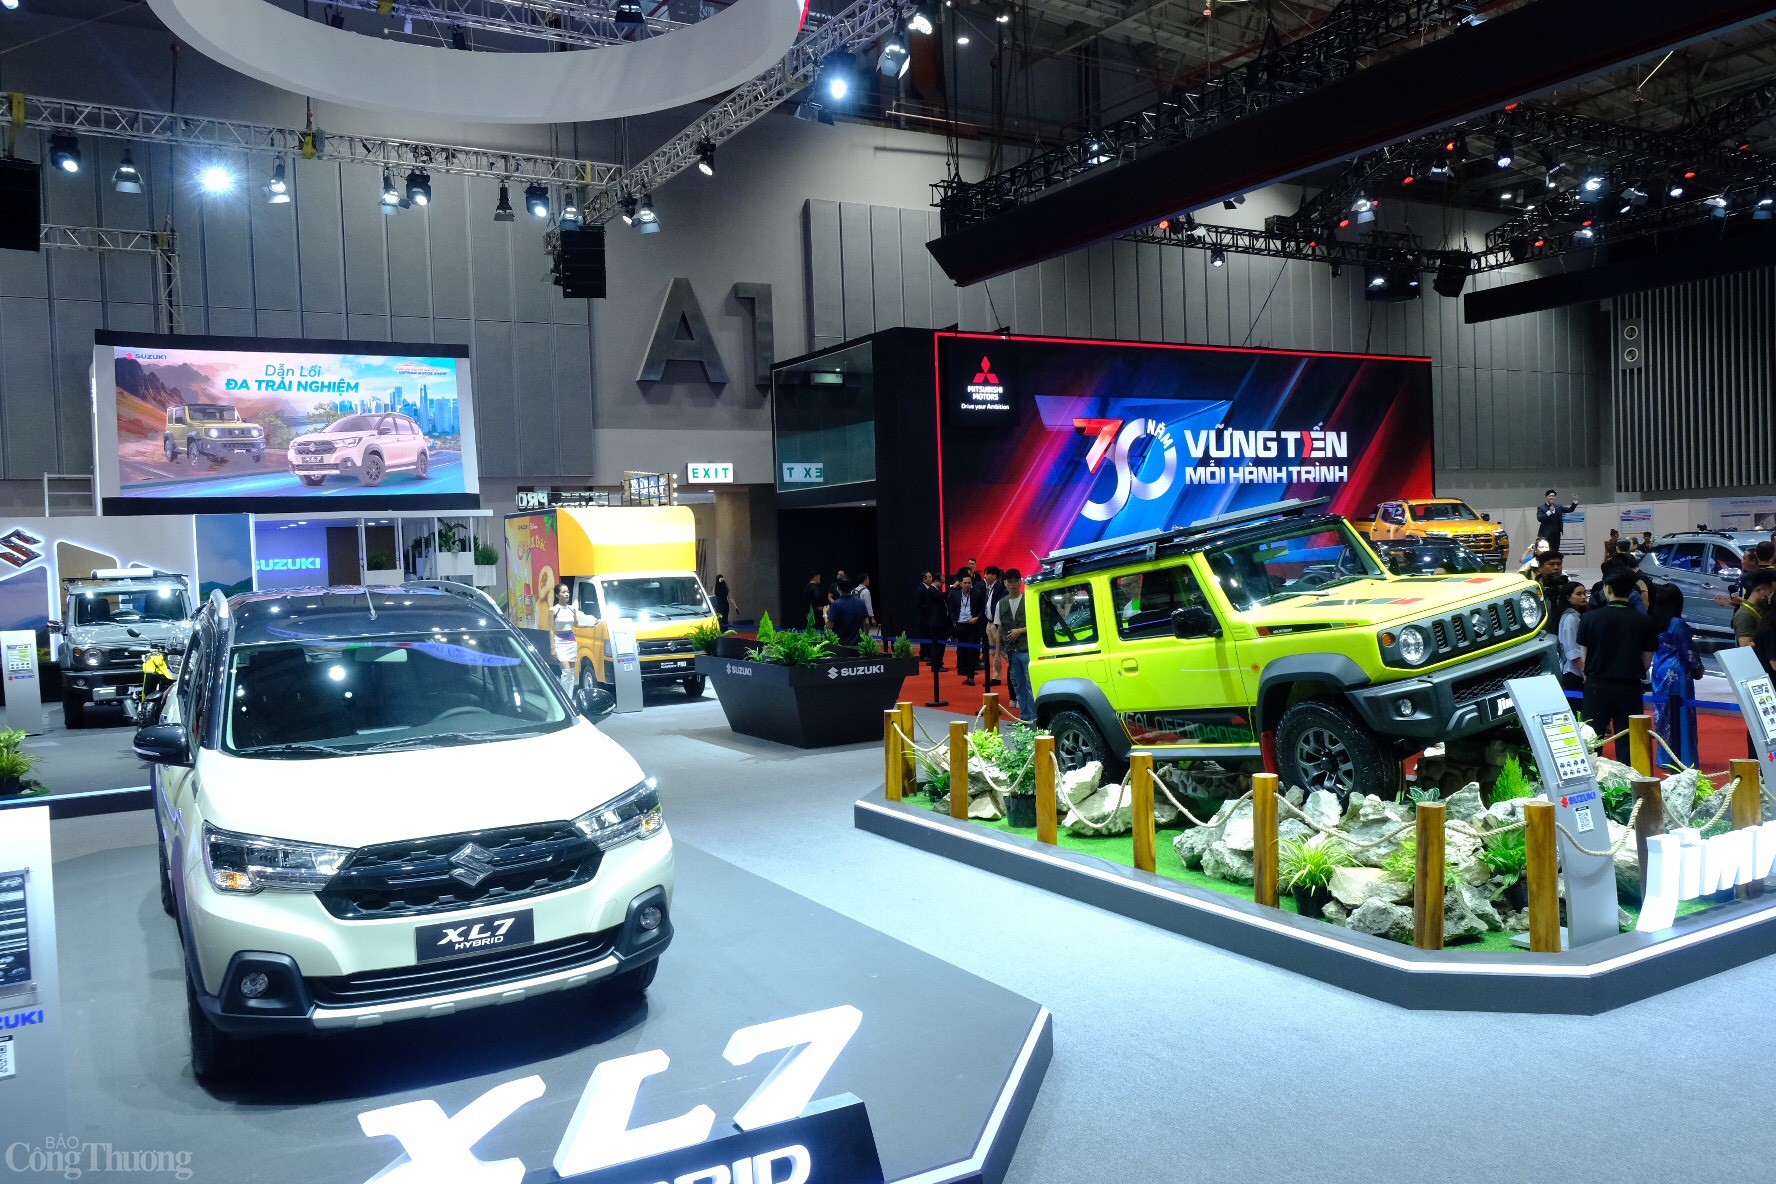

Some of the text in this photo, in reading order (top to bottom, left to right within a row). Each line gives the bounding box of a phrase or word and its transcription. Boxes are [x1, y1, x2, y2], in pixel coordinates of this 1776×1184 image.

[636, 277, 774, 384] A1
[265, 363, 321, 377] Dẫn Lối
[225, 377, 359, 396] ĐA TRẢI NGHIỆM
[967, 385, 1003, 393] MITSUBISHI
[1184, 423, 1278, 458] VỮNG
[692, 467, 729, 479] EXIT
[1073, 418, 1177, 521] 30
[1185, 460, 1348, 485] MỖI HÀNH TRÌNH
[732, 665, 752, 676] SUZUKI
[840, 664, 884, 677] SUZUKI
[1568, 791, 1597, 805] SUZUKI
[437, 917, 515, 945] XL7
[454, 935, 504, 950] HYBRID
[357, 1004, 863, 1184] XL7
